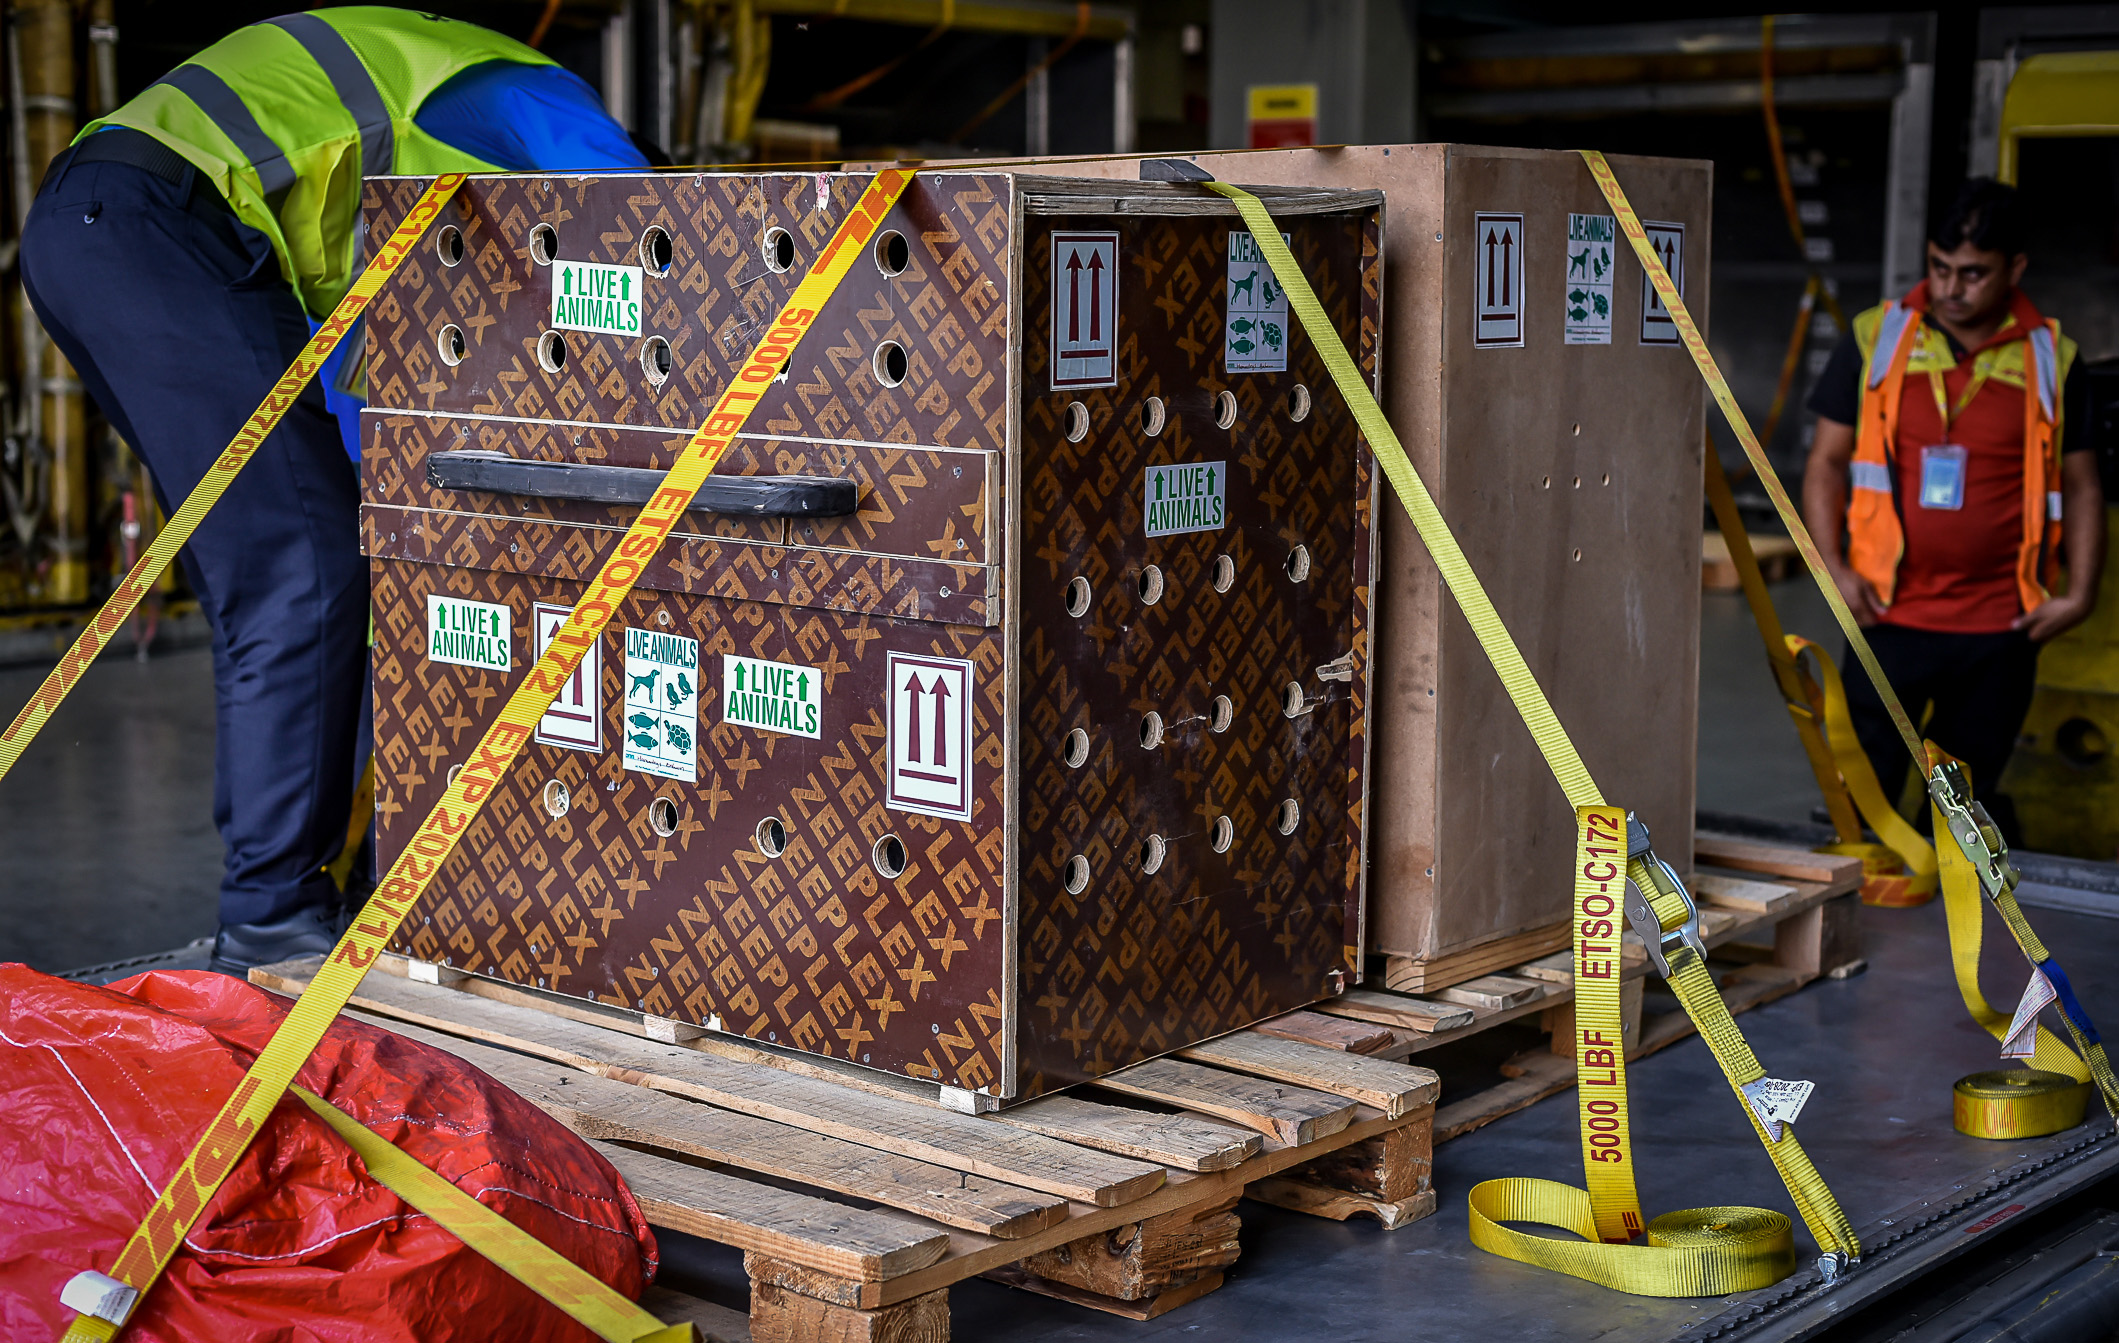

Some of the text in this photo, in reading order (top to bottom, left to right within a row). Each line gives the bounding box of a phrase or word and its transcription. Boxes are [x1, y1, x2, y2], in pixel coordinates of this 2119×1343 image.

[1230, 233, 1249, 261] LIVE
[578, 267, 617, 299] LIVE
[315, 295, 370, 355] EXP
[555, 296, 638, 332] ANIMALS
[740, 307, 814, 383] 5000
[217, 360, 317, 471] 2027/09
[695, 391, 759, 461] LBF
[1169, 466, 1204, 499] LIVE
[1148, 495, 1222, 532] ANIMALS
[452, 604, 487, 635] LIVE
[524, 488, 692, 696] ETSO-C172
[432, 630, 508, 667] ANIMALS
[628, 630, 697, 668] LIVE ANIMALS
[752, 664, 793, 698] LIVE
[727, 691, 817, 733] ANIMALS
[459, 721, 531, 805] EXP
[334, 808, 467, 968] 2028/12
[486, 781, 596, 967] EEPLEX
[790, 772, 937, 1002] ZEEPLEX
[732, 835, 873, 1061] ZEEPLEX
[1581, 813, 1623, 1164] 5000 LBF ETSO-C172
